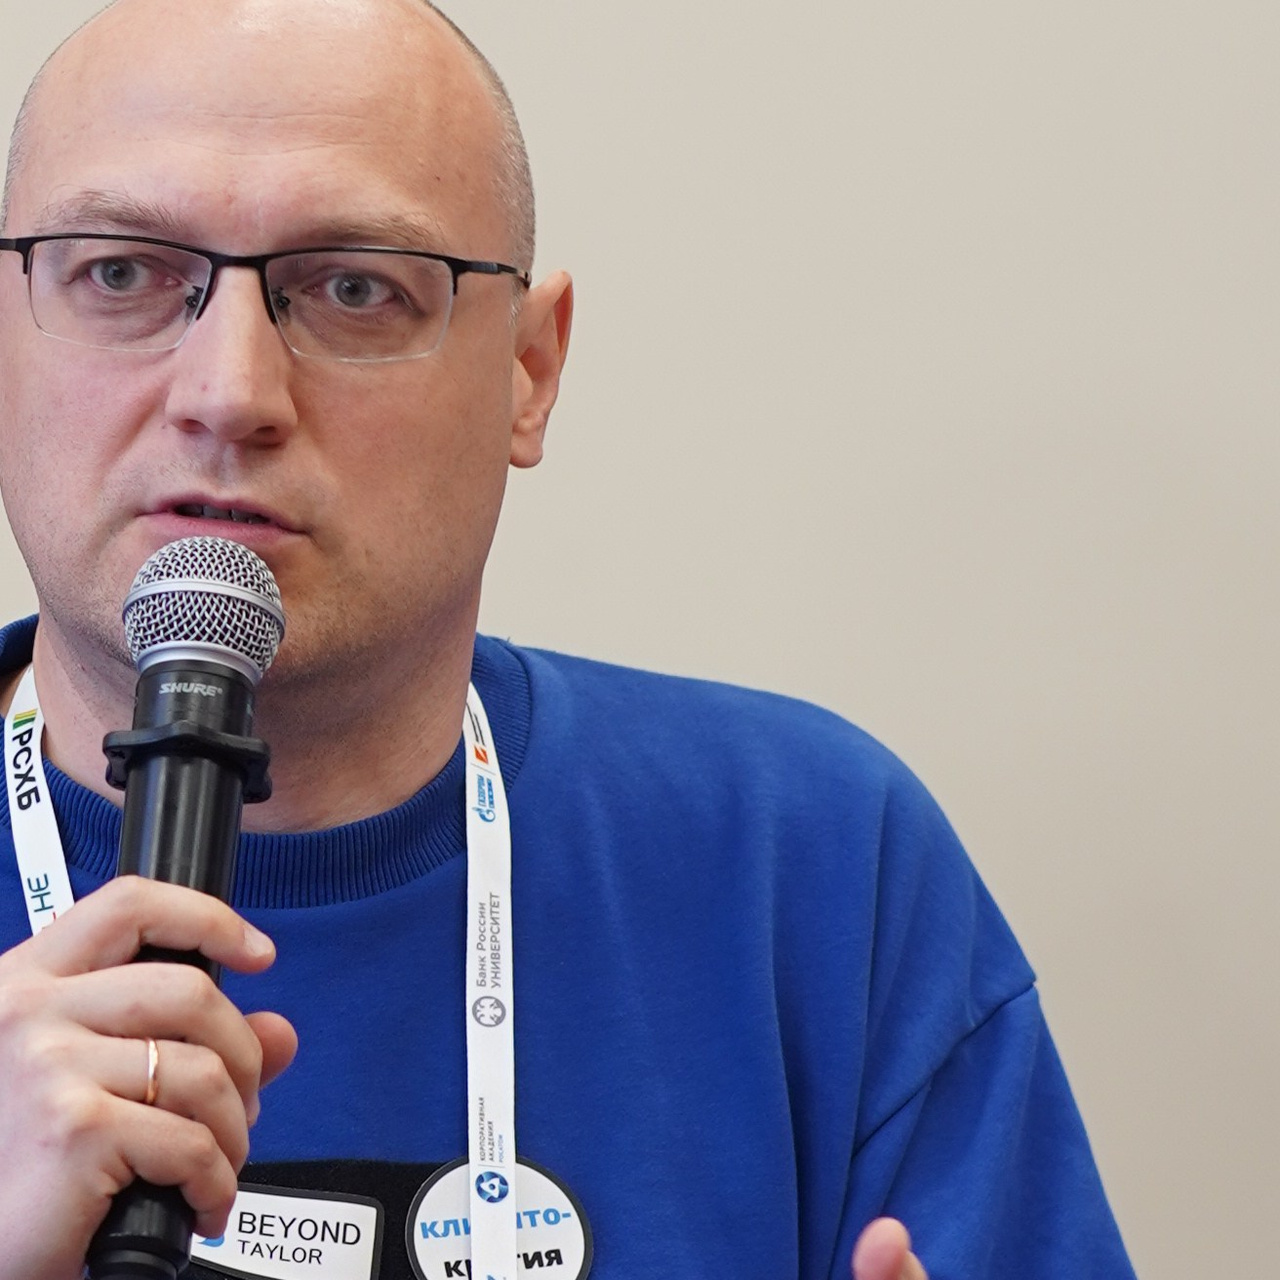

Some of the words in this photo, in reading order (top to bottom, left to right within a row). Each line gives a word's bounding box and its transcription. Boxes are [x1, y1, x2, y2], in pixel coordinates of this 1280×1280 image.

[12, 727, 41, 811] РСХБ
[26, 872, 57, 922] ЭН
[476, 901, 487, 952] России
[489, 891, 502, 990] УНИВЕРСИТЕТ
[475, 955, 487, 988] Банк
[478, 1096, 486, 1162] КОРПОРАТИВНАЯ
[487, 1120, 495, 1162] АКАДЕМИЯ
[237, 1211, 361, 1246] BEYOND
[237, 1239, 323, 1266] TAYLOR
